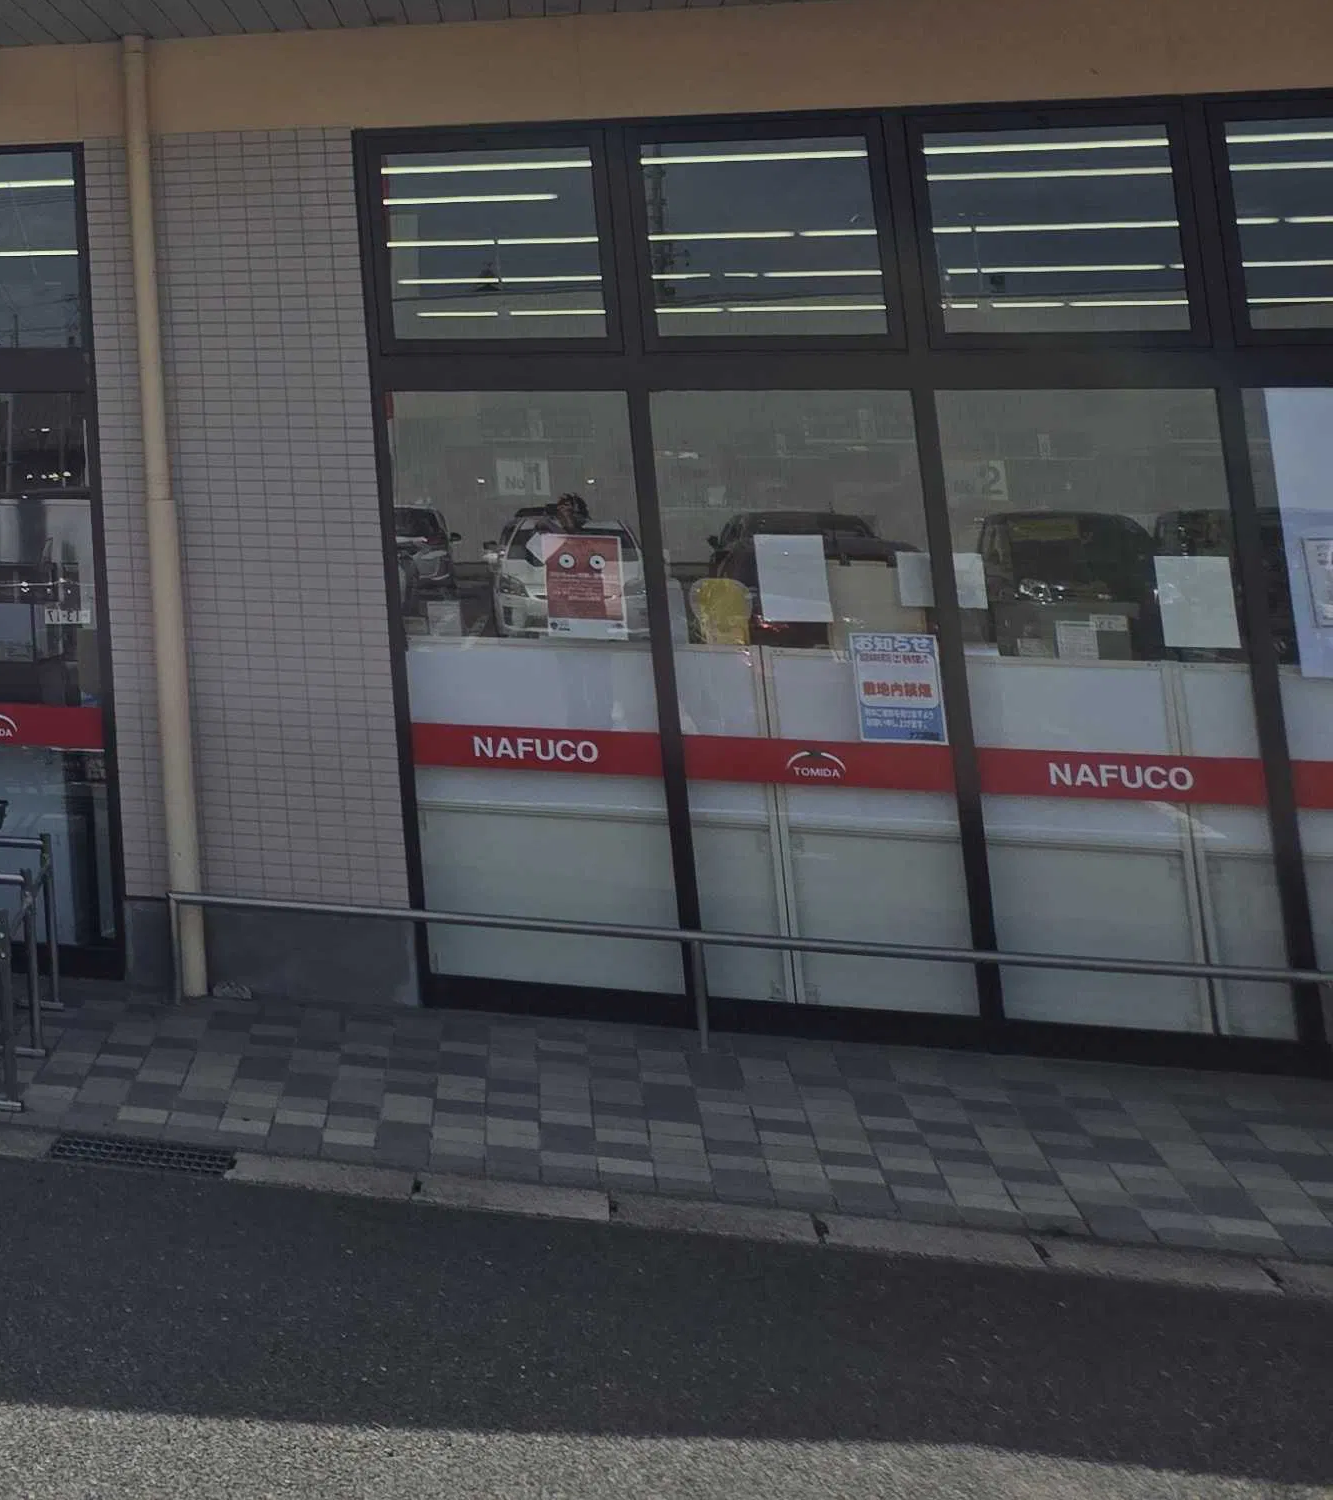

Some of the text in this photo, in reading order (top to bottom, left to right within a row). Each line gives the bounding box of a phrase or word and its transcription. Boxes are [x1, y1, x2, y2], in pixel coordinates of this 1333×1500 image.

[855, 637, 930, 653] お知らせ
[472, 736, 599, 764] NAFUCO
[793, 765, 841, 779] TOMIDA
[1048, 763, 1194, 792] NAFUCO
